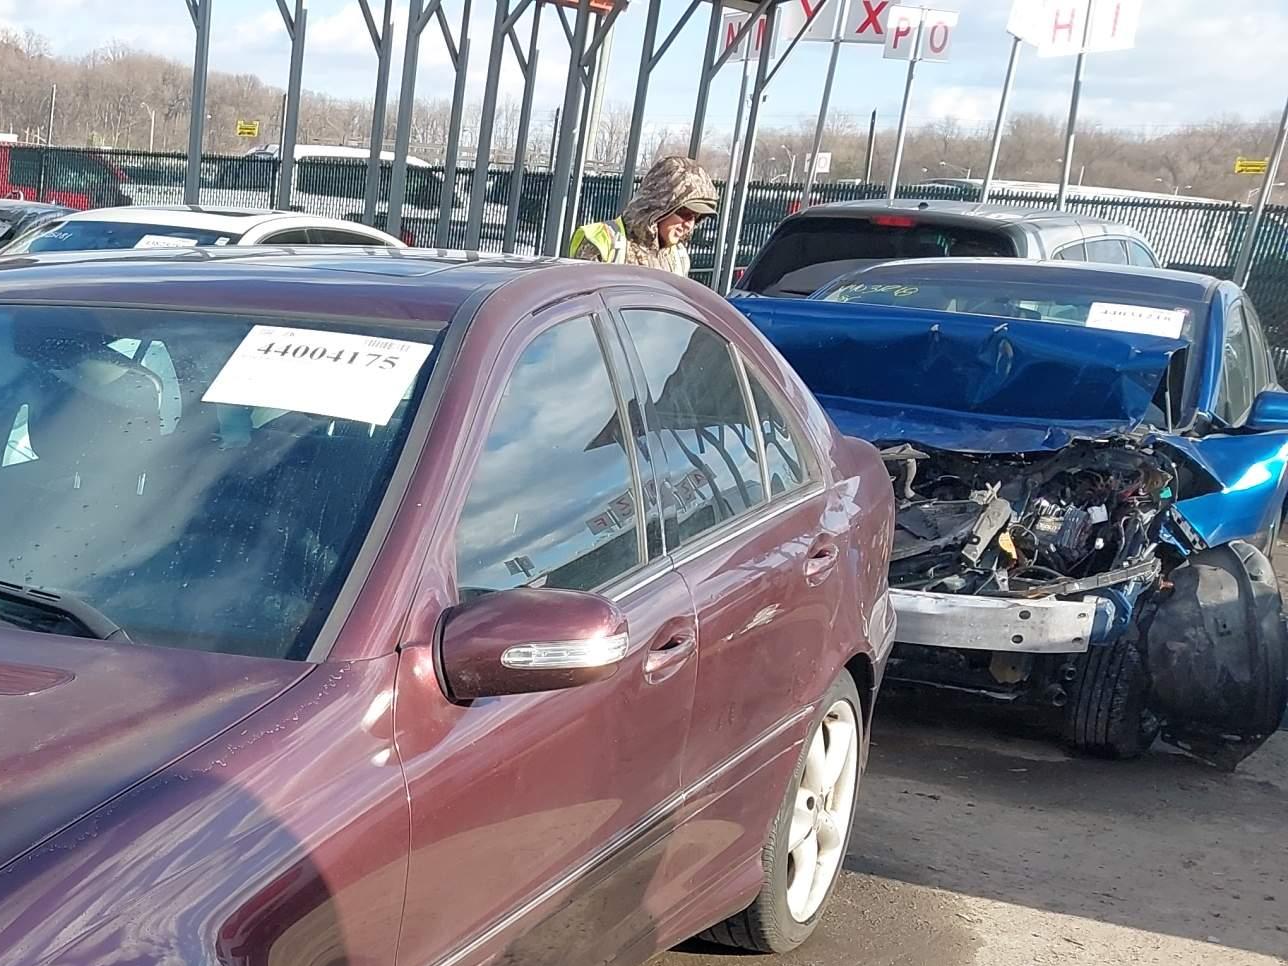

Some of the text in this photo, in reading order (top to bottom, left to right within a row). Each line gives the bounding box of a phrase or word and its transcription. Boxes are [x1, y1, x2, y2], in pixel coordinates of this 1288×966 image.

[855, 0, 889, 34] X
[892, 17, 911, 49] P
[1052, 8, 1075, 44] H
[257, 342, 400, 370] 44004175
